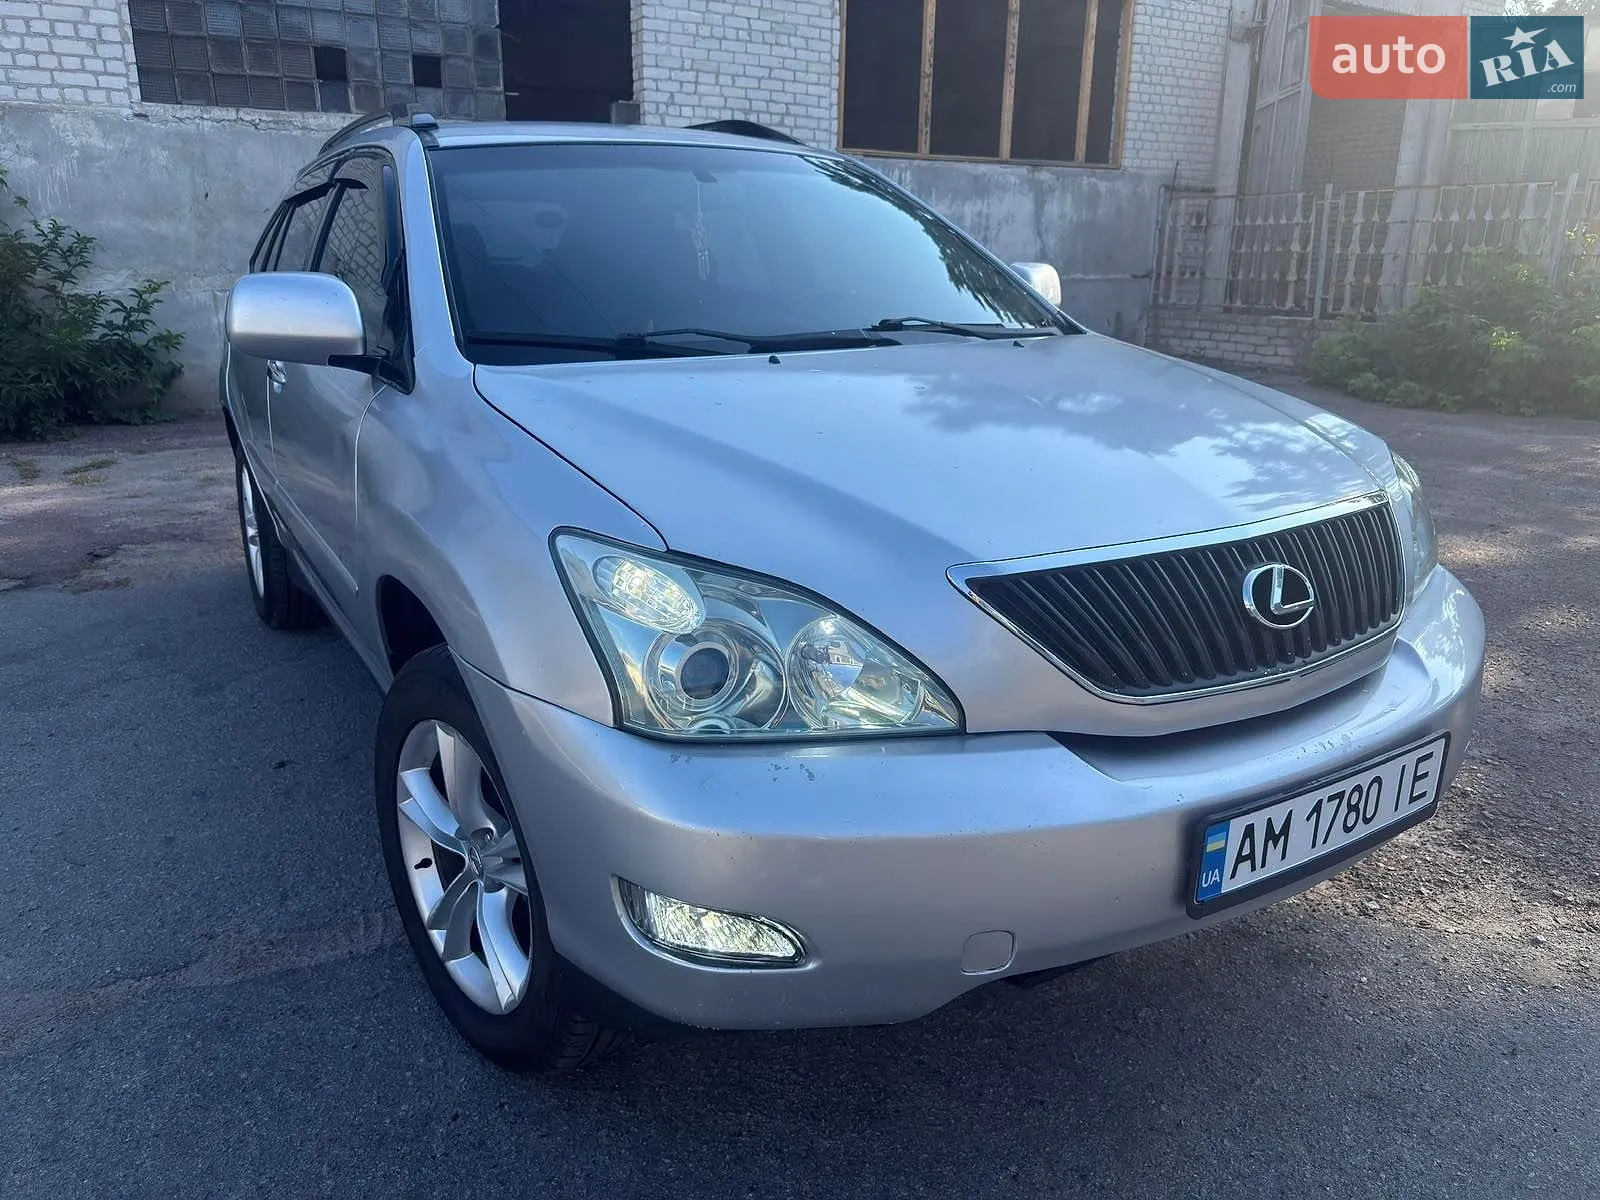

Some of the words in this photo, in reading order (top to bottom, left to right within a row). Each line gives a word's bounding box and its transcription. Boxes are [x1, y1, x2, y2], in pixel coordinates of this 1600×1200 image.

[1230, 808, 1293, 880] AM
[1306, 775, 1383, 849] 1780
[1393, 751, 1434, 812] IE
[1201, 869, 1221, 888] UA
